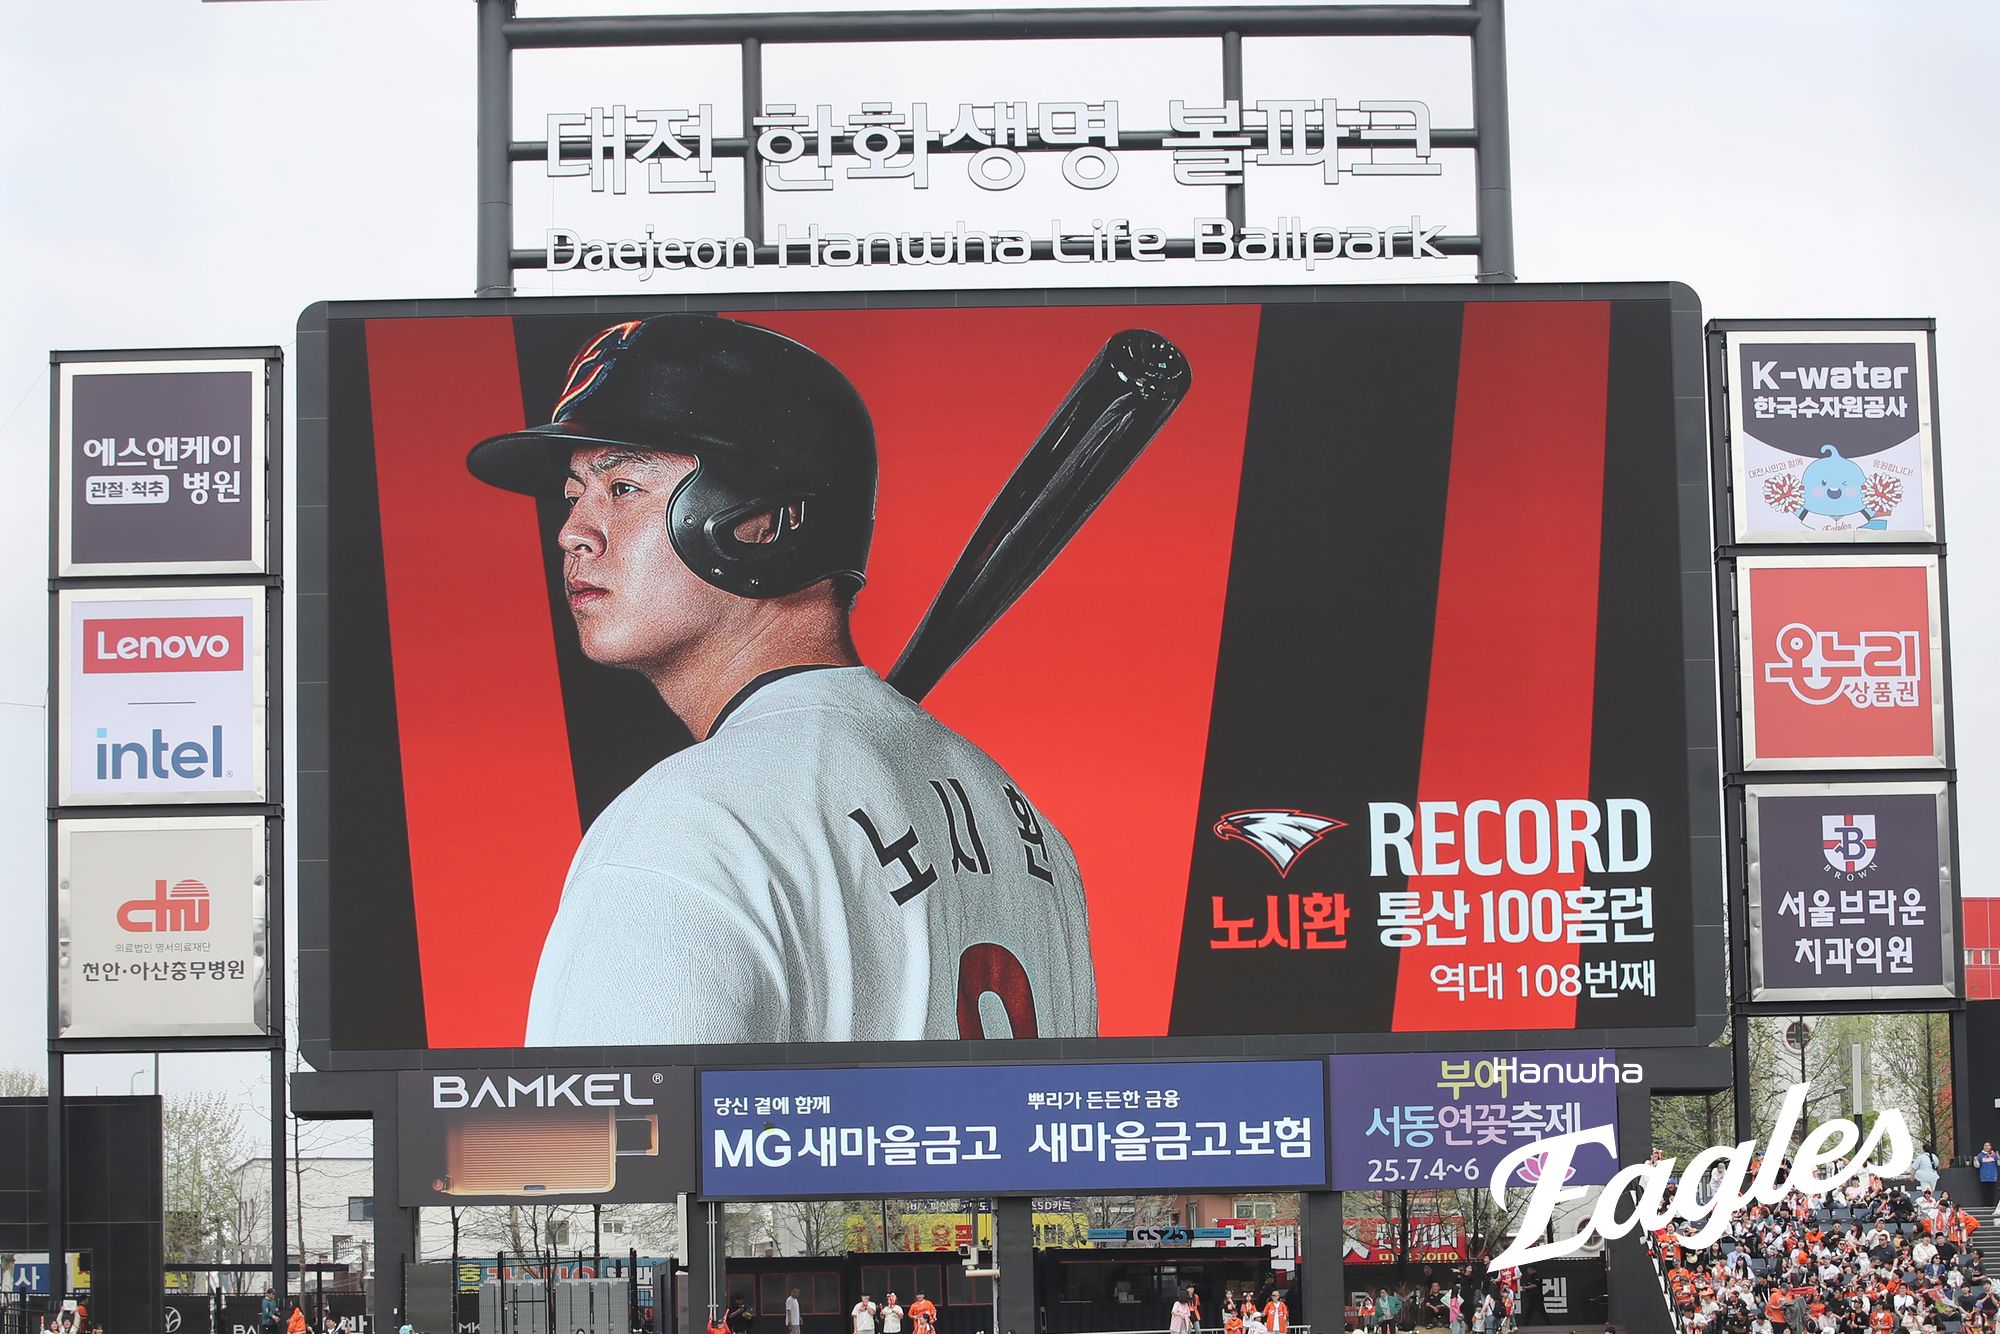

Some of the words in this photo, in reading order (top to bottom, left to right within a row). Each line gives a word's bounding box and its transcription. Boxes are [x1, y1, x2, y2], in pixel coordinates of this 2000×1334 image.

[547, 103, 717, 195] 대전
[752, 100, 1120, 193] 한화생명
[1162, 97, 1443, 186] 볼파크
[546, 223, 756, 282] Daejeon
[777, 220, 1032, 268] Hanwha
[1051, 217, 1167, 264] Life
[1193, 214, 1448, 272] Ballpark
[1751, 360, 1910, 391] K-water
[1753, 395, 1909, 419] 한국수자원공사
[83, 434, 241, 470] 에스앤케이
[183, 470, 241, 505] 병원
[97, 631, 230, 660] Lenovo
[1850, 680, 1915, 704] 상품권
[96, 725, 223, 781] intel
[847, 778, 1055, 907] 노시환
[1367, 798, 1653, 877] RECORD
[1823, 862, 1878, 882] BROWN
[1209, 891, 1351, 950] 노시환
[1376, 888, 1471, 948] 통산
[1480, 886, 1655, 944] 100홈런
[1777, 887, 1927, 928] 서울브라운
[115, 943, 153, 954] 의료법인
[1794, 935, 1914, 975] 치과의원
[1429, 961, 1504, 1001] 역대
[1515, 959, 1657, 999] 108번째
[432, 1073, 655, 1109] BAMKEL
[713, 1097, 749, 1116] 당신
[754, 1096, 790, 1115] 곁에
[794, 1095, 832, 1115] 함께
[1027, 1091, 1082, 1110] 뿌리가
[1086, 1090, 1140, 1110] 든든한
[1145, 1089, 1181, 1109] 금융
[1365, 1101, 1581, 1148] 서동연꽃축제
[1367, 1157, 1480, 1183] 25.7.4~6
[1132, 1225, 1189, 1244] GS25
